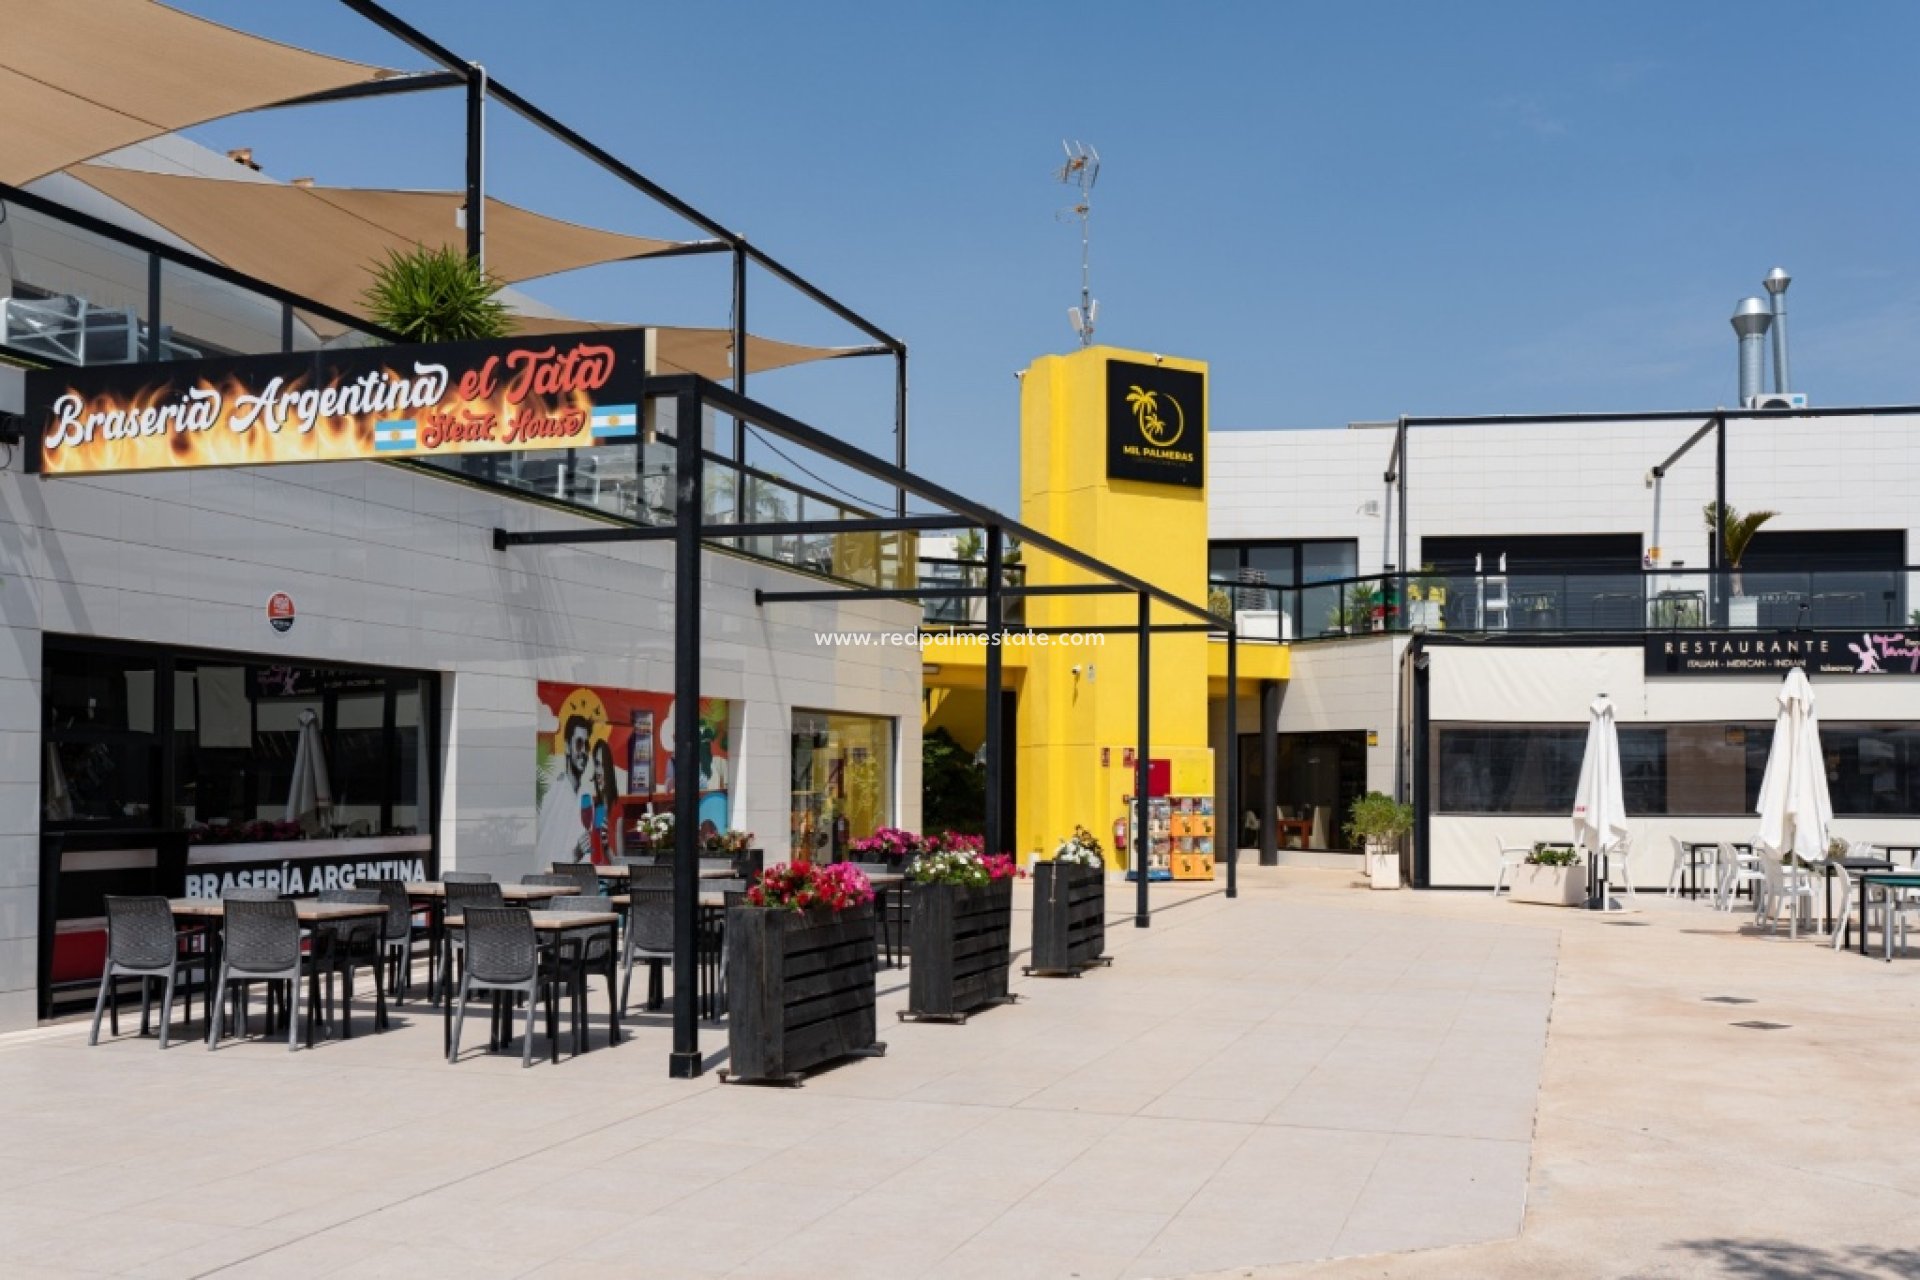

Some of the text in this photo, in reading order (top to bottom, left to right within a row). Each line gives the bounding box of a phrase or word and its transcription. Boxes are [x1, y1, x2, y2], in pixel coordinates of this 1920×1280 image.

[45, 343, 615, 449] Braseria Argentina el Tata
[422, 406, 586, 448] Steak House
[1123, 445, 1193, 462] MIL PALMERAS
[1664, 640, 1829, 654] RESTAURANTE
[1687, 659, 1719, 668] ITALIAN
[1726, 659, 1766, 668] MEXICAN
[186, 859, 426, 900] BRASERÍA ARGENTINA
